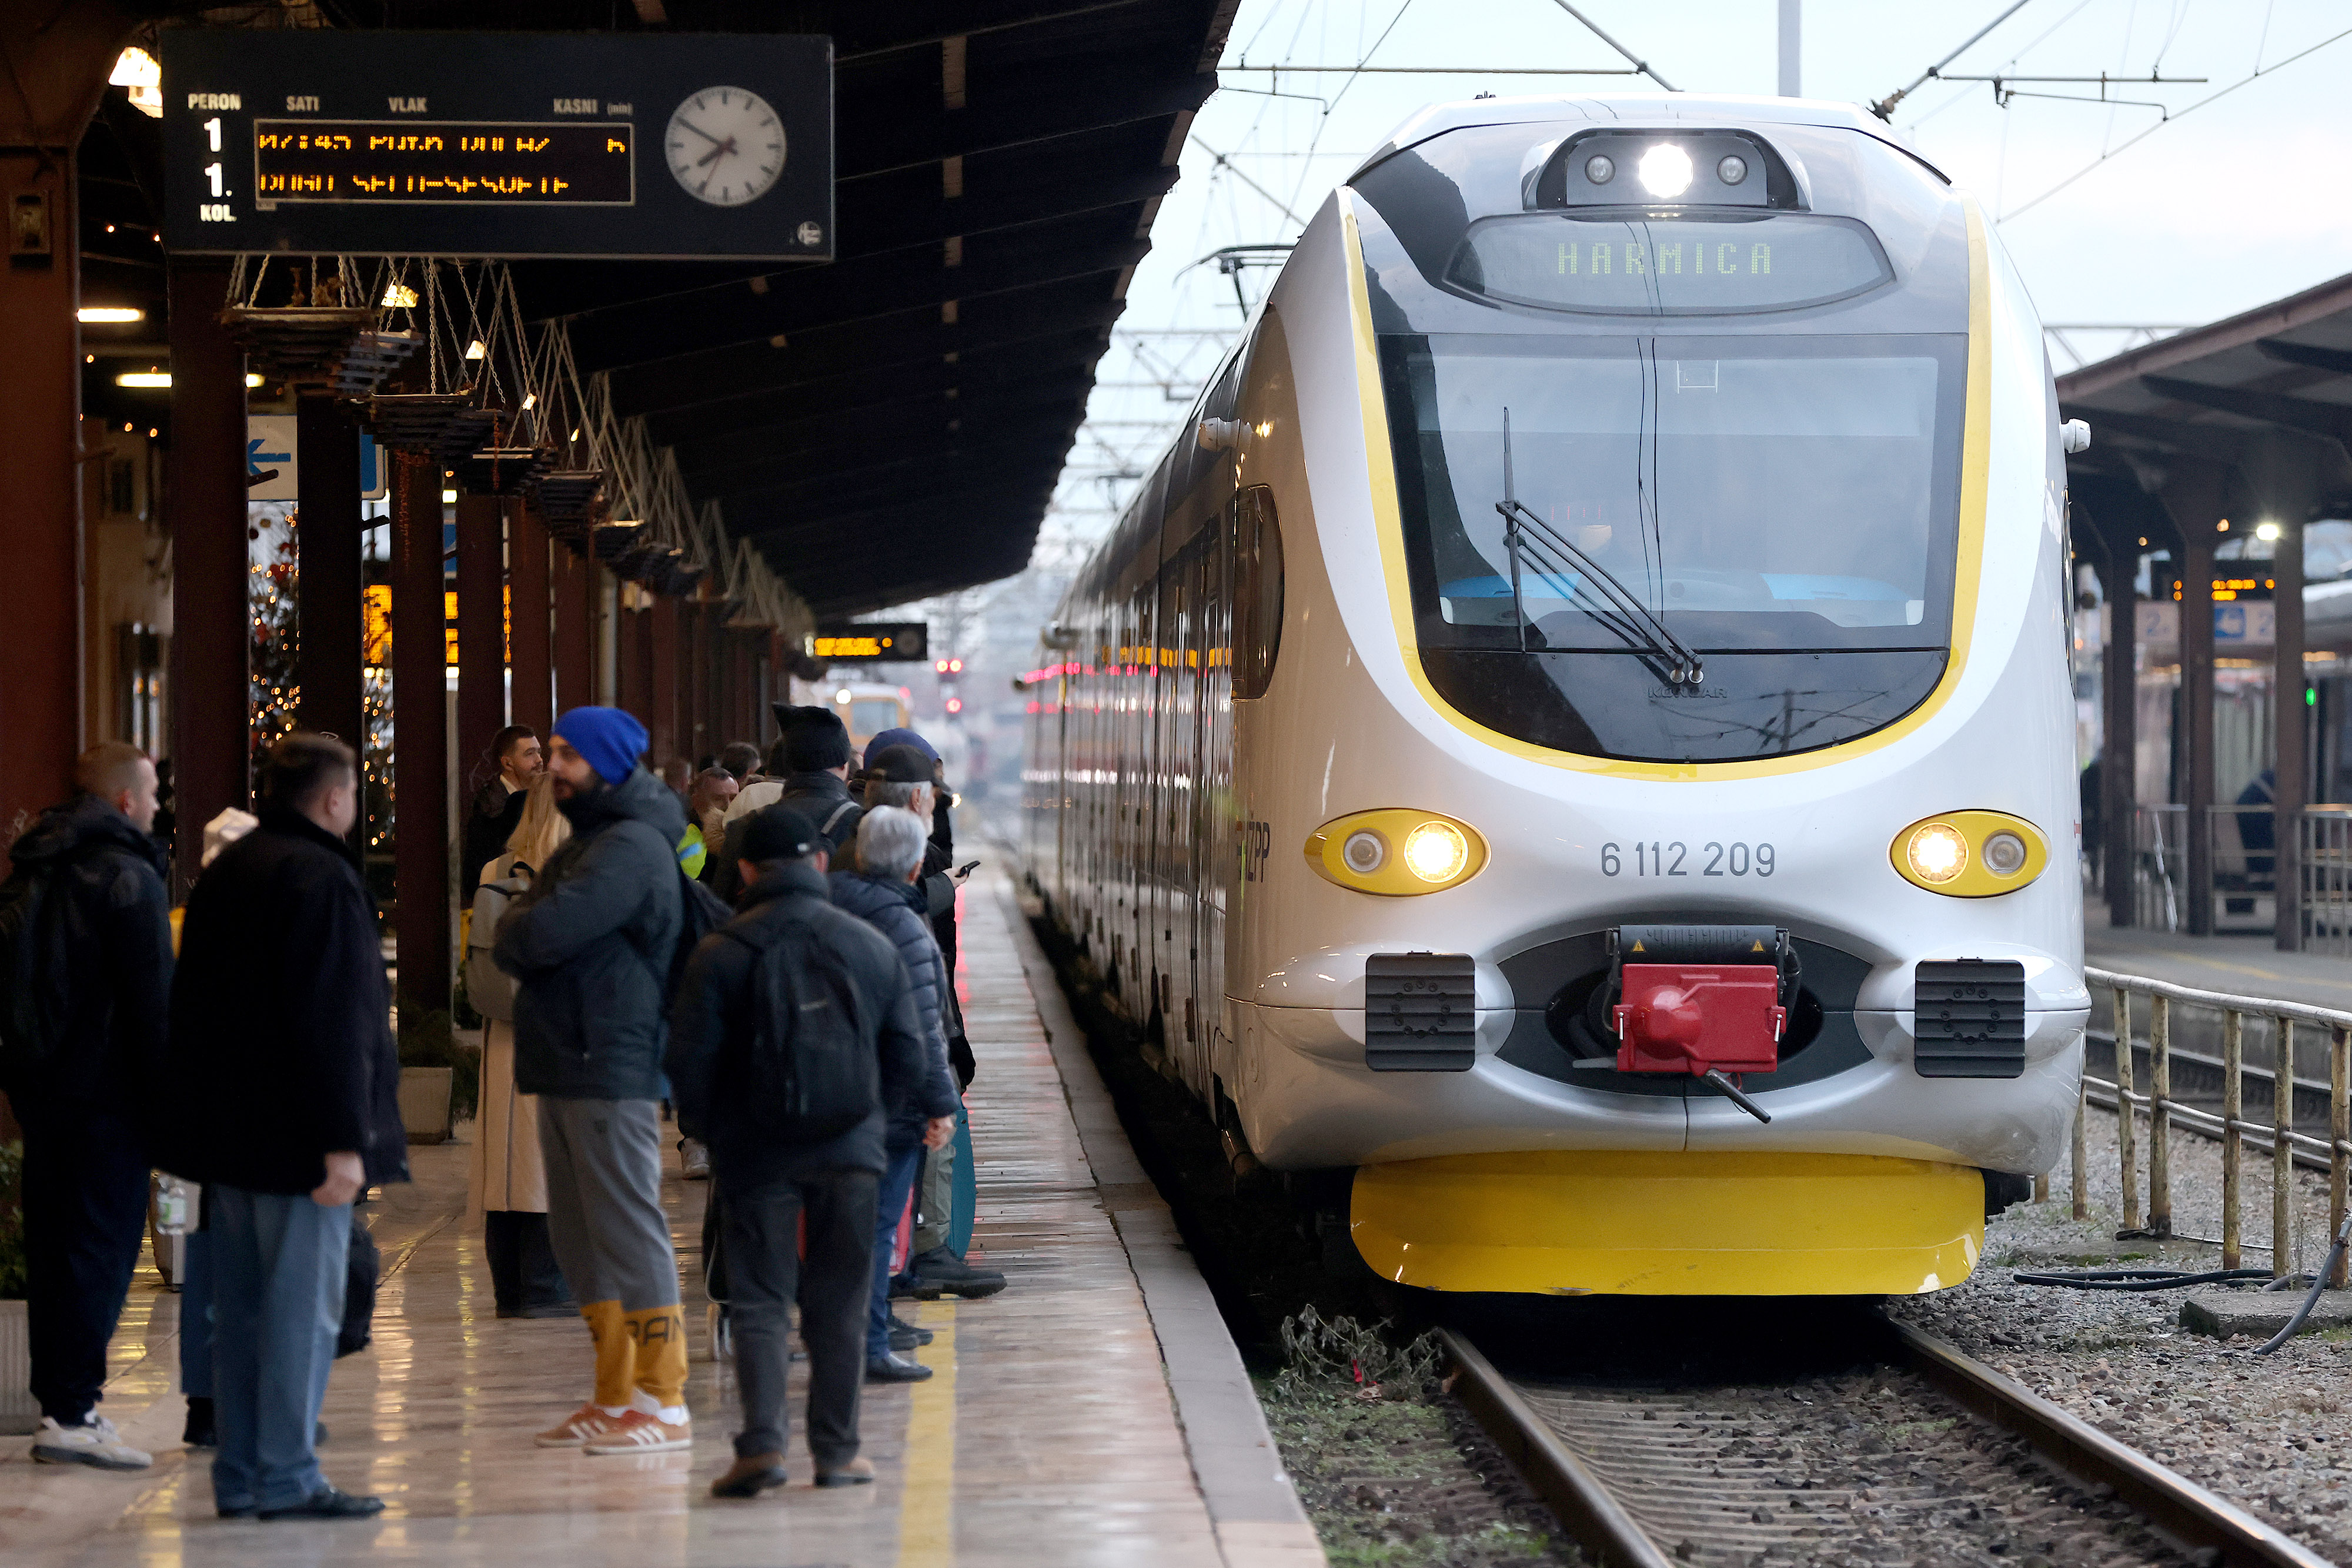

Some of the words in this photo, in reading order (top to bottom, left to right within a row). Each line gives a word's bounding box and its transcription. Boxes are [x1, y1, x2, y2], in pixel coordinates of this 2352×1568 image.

[188, 93, 242, 111] PERON
[286, 95, 320, 112] SATI
[389, 96, 428, 113] VLAK
[553, 98, 599, 114] KASNI
[607, 102, 633, 116] (min)
[203, 117, 222, 152] 1
[204, 162, 233, 198] 1.
[200, 204, 237, 222] KOL.
[1558, 243, 1770, 275] HARMICA
[1601, 842, 1621, 877] 6
[1635, 841, 1687, 876] 112
[1703, 841, 1775, 877] 209
